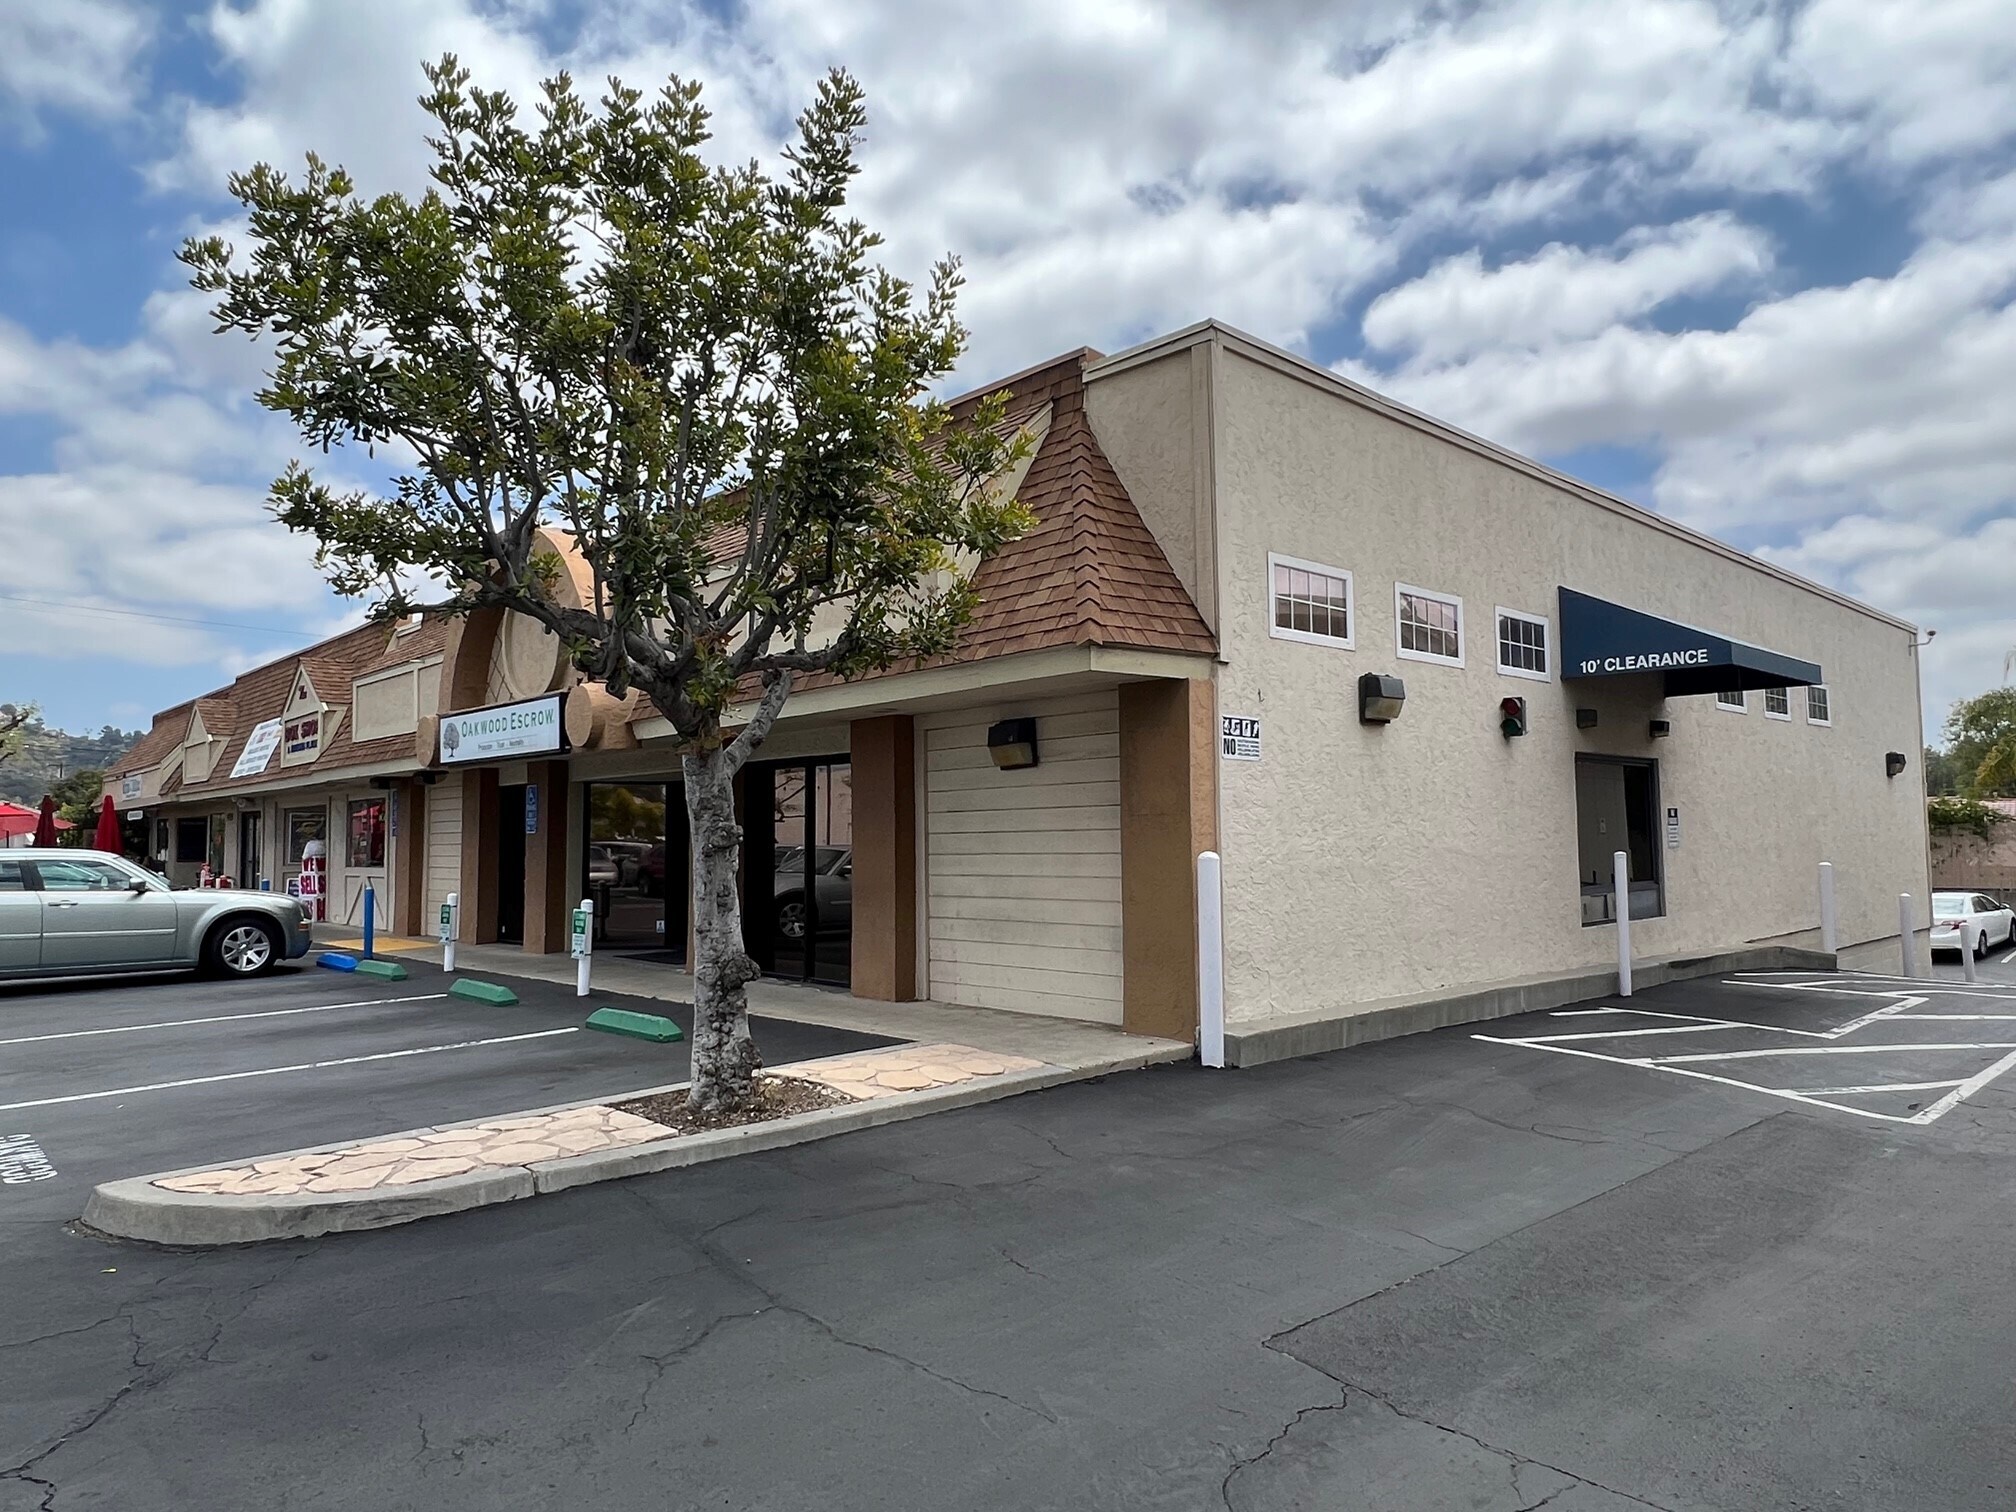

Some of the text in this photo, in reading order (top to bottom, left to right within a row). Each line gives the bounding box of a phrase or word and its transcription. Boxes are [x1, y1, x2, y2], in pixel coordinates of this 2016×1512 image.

[1579, 648, 1709, 674] 10' CLEARANCE
[461, 708, 554, 737] OAKWOOD ESCROW
[1223, 738, 1236, 755] NO
[301, 875, 317, 894] SELL
